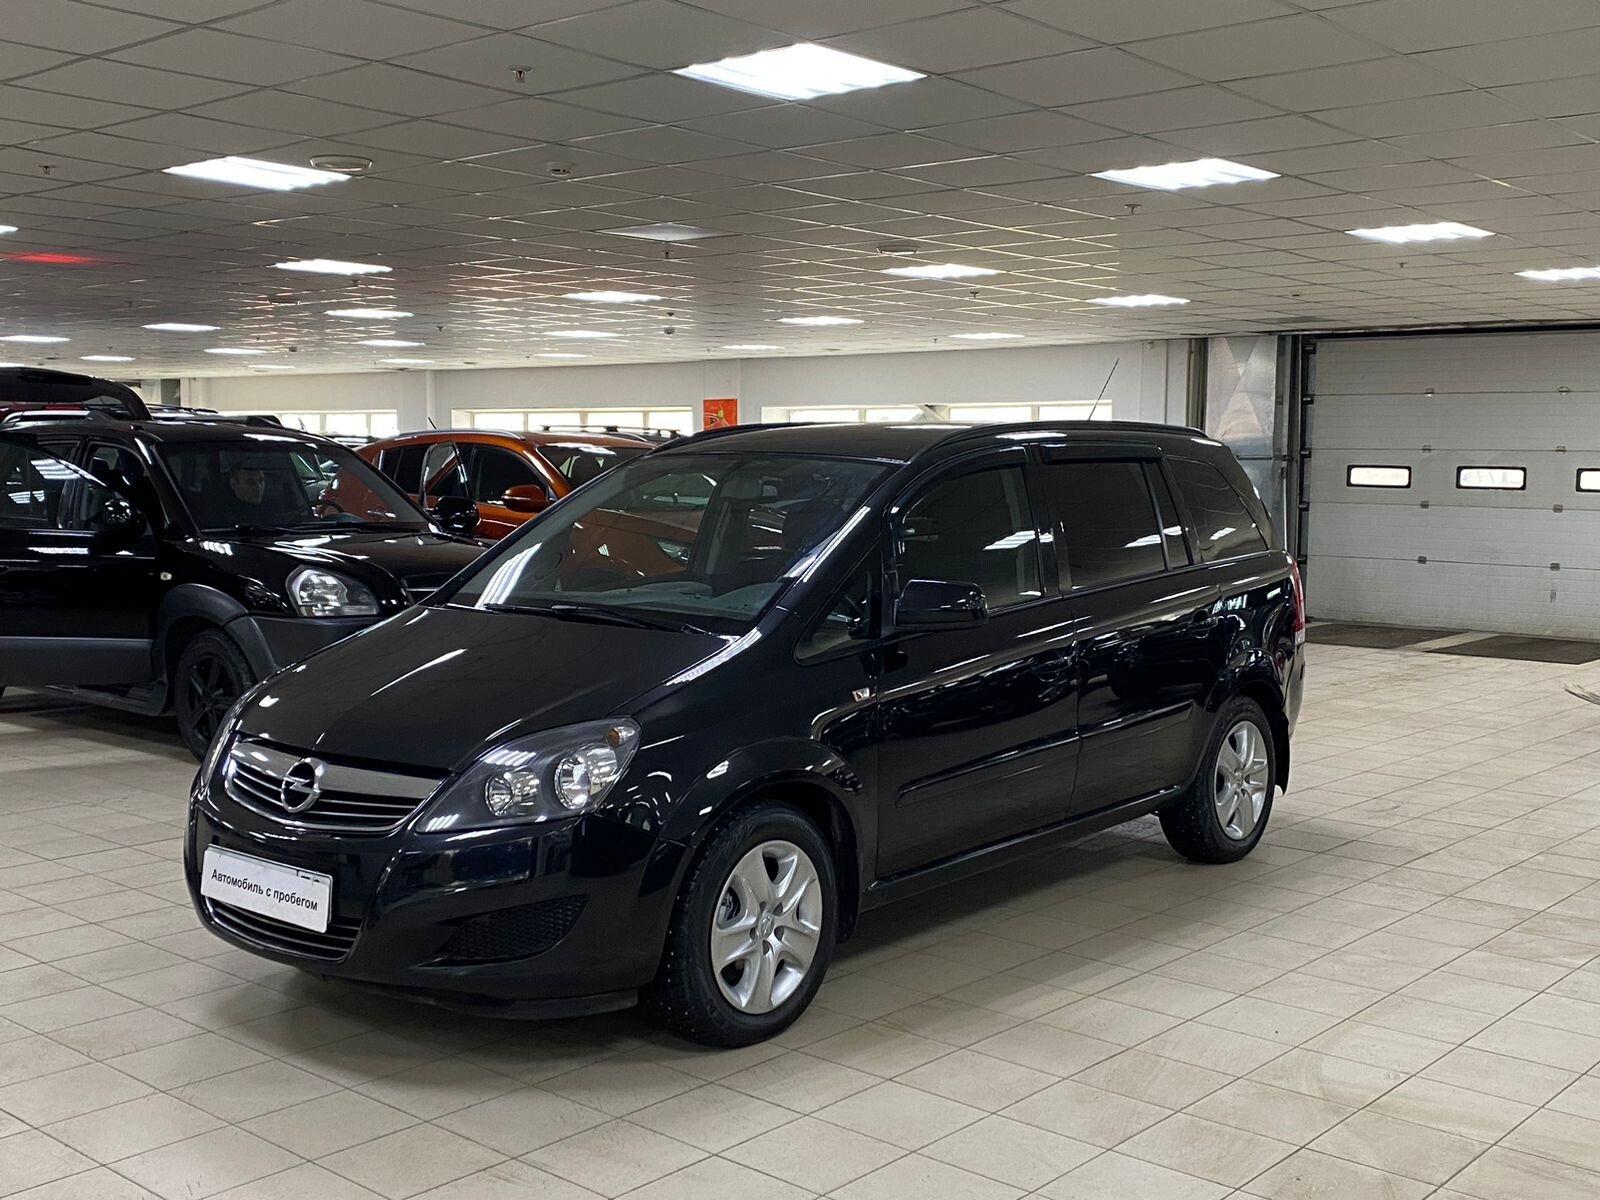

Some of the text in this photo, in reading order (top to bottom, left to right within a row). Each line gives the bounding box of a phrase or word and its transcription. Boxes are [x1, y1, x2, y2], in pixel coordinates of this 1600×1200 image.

[211, 868, 318, 911] Автомобиль с пробегом
